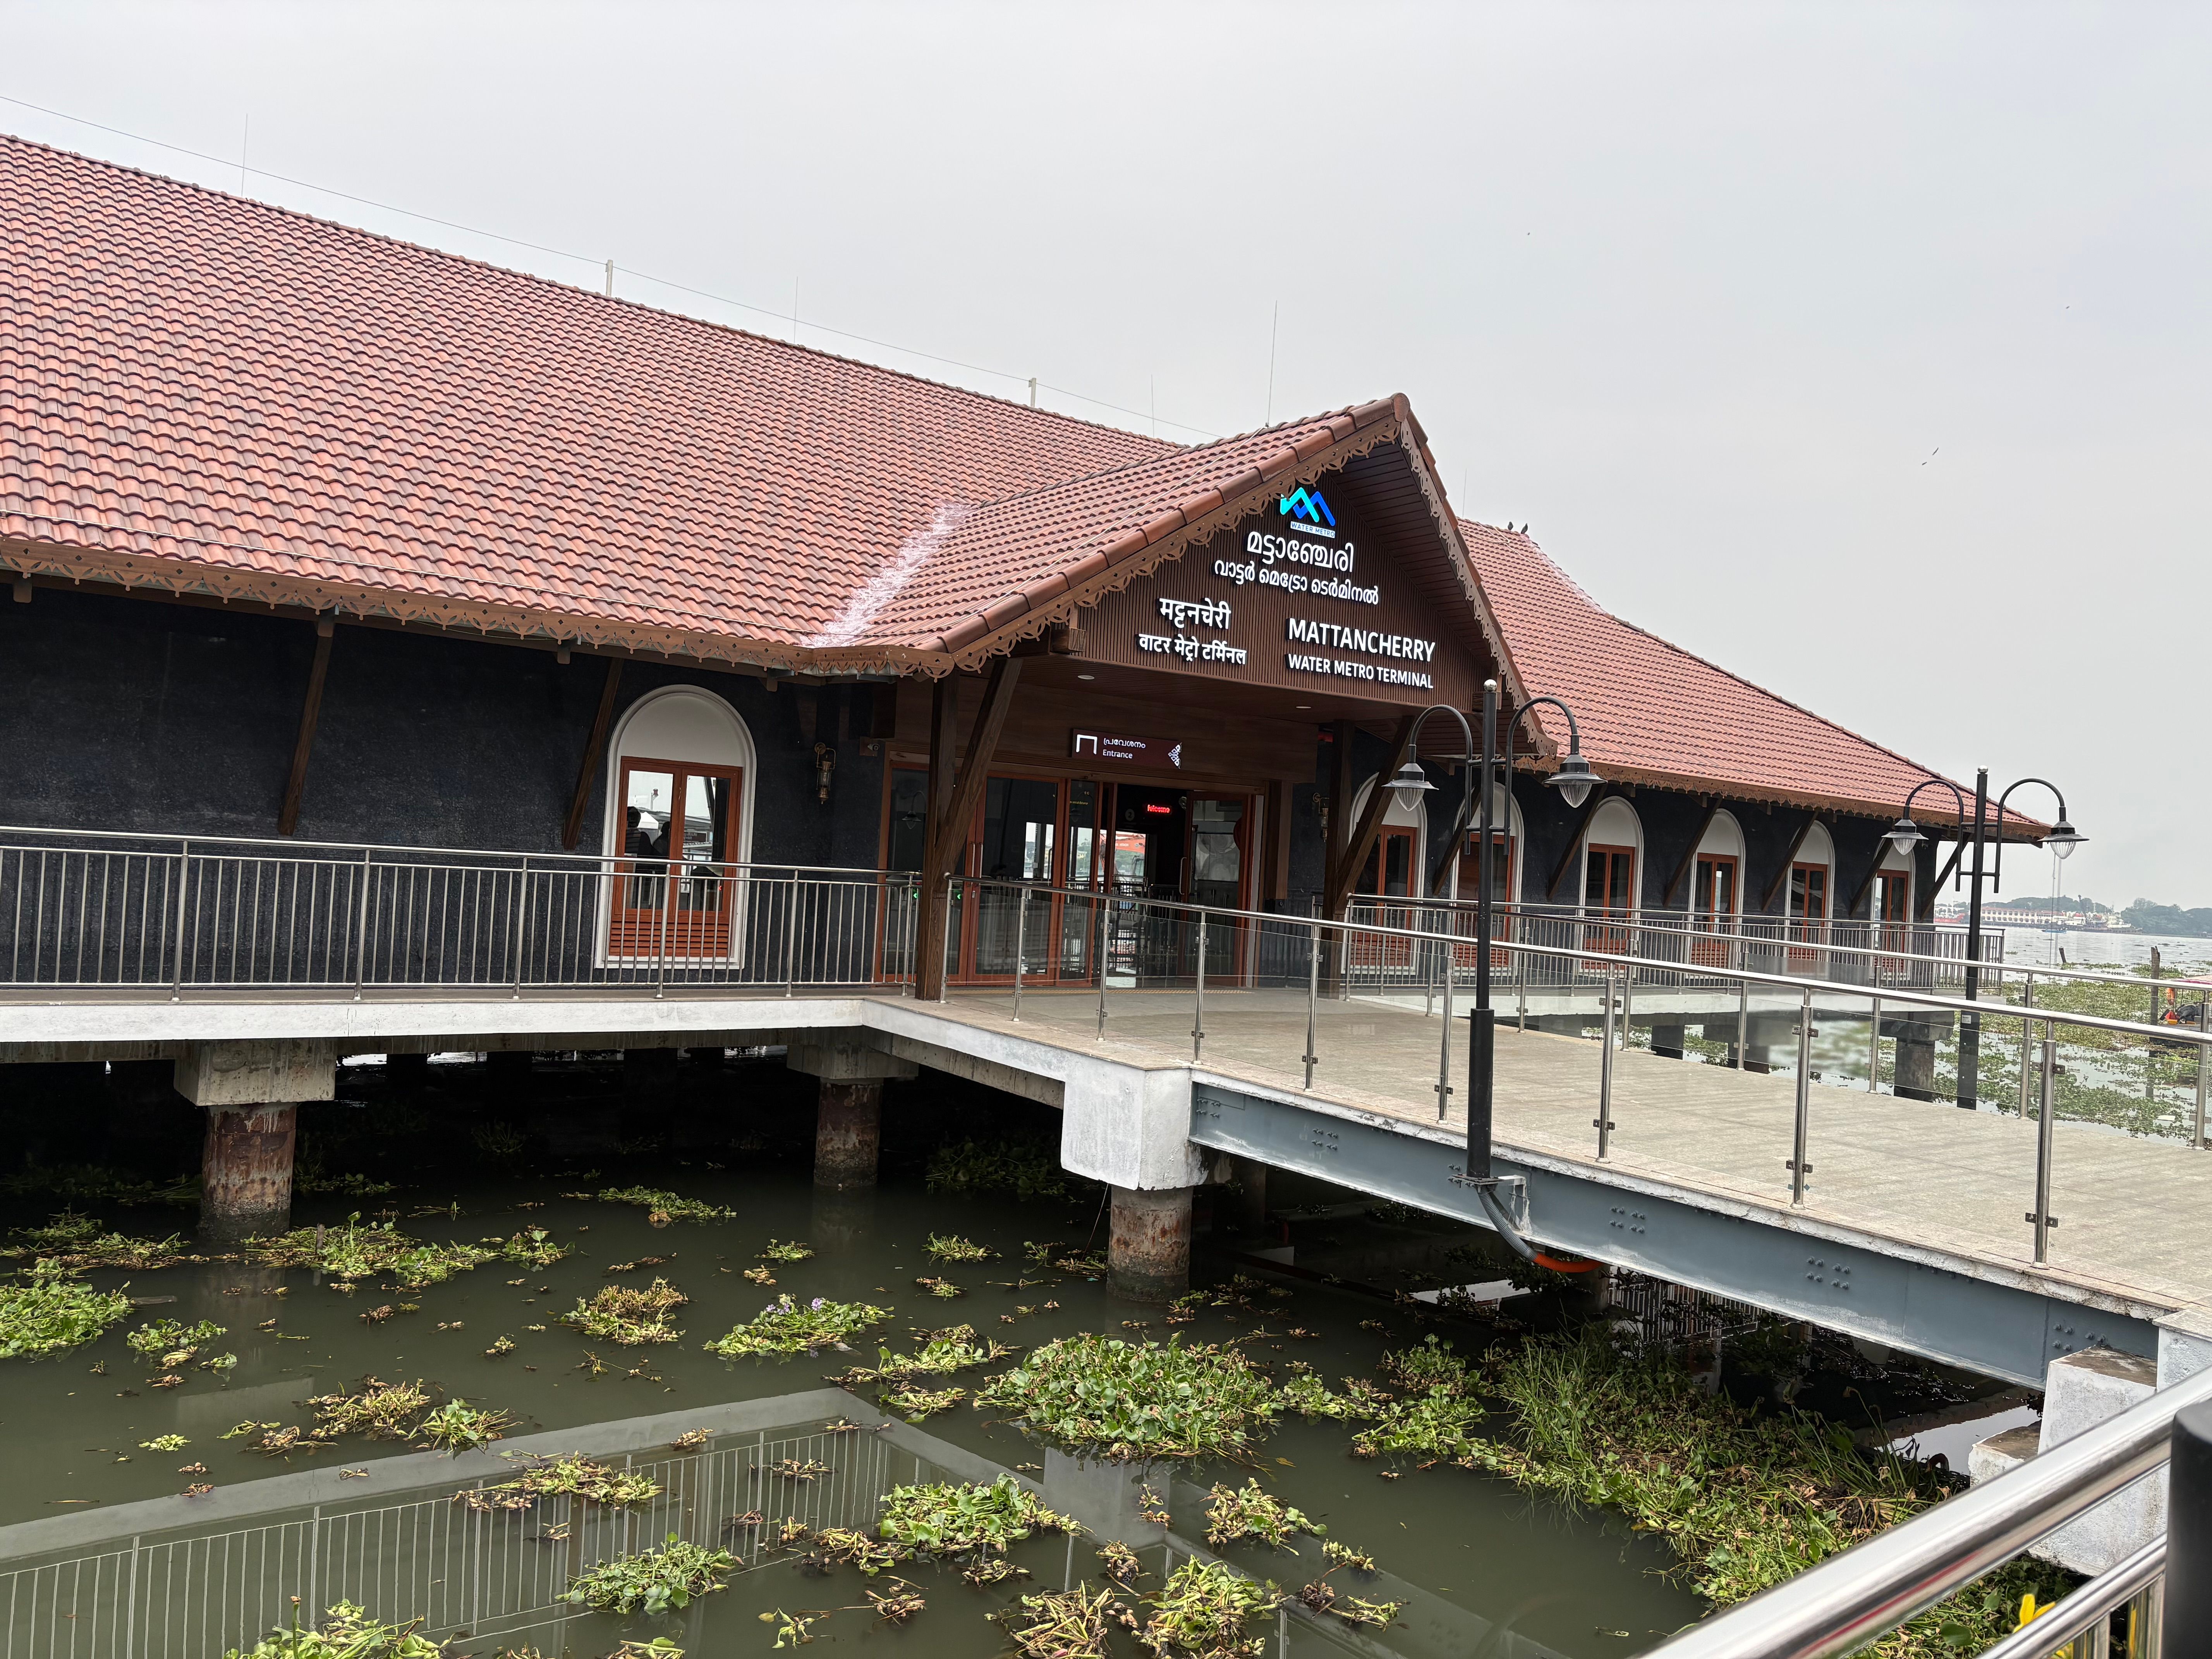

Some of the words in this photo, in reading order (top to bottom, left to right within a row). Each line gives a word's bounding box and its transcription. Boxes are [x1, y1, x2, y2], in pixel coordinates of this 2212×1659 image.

[1291, 522, 1313, 532] WATER
[1315, 527, 1335, 537] METRO
[1247, 531, 1354, 572] മട്ടാഞ്ചേരി
[1214, 560, 1255, 585] വാട്ടർ
[1259, 568, 1307, 593] മെട്രോ
[1311, 577, 1379, 605] ടെർമിനൽ
[1159, 597, 1231, 629] मट्टनचेरी
[1139, 634, 1172, 654] वाटर
[1174, 634, 1200, 662] मेट्रो
[1201, 640, 1247, 665] टर्मिनल
[1289, 618, 1436, 662] MATTANCHERRY
[1288, 653, 1331, 673] WATER
[1334, 660, 1374, 680] METRO
[1376, 666, 1434, 689] TERMINAL
[1103, 738, 1146, 749] പ്രവേശനം
[1103, 749, 1133, 759] Entrance
